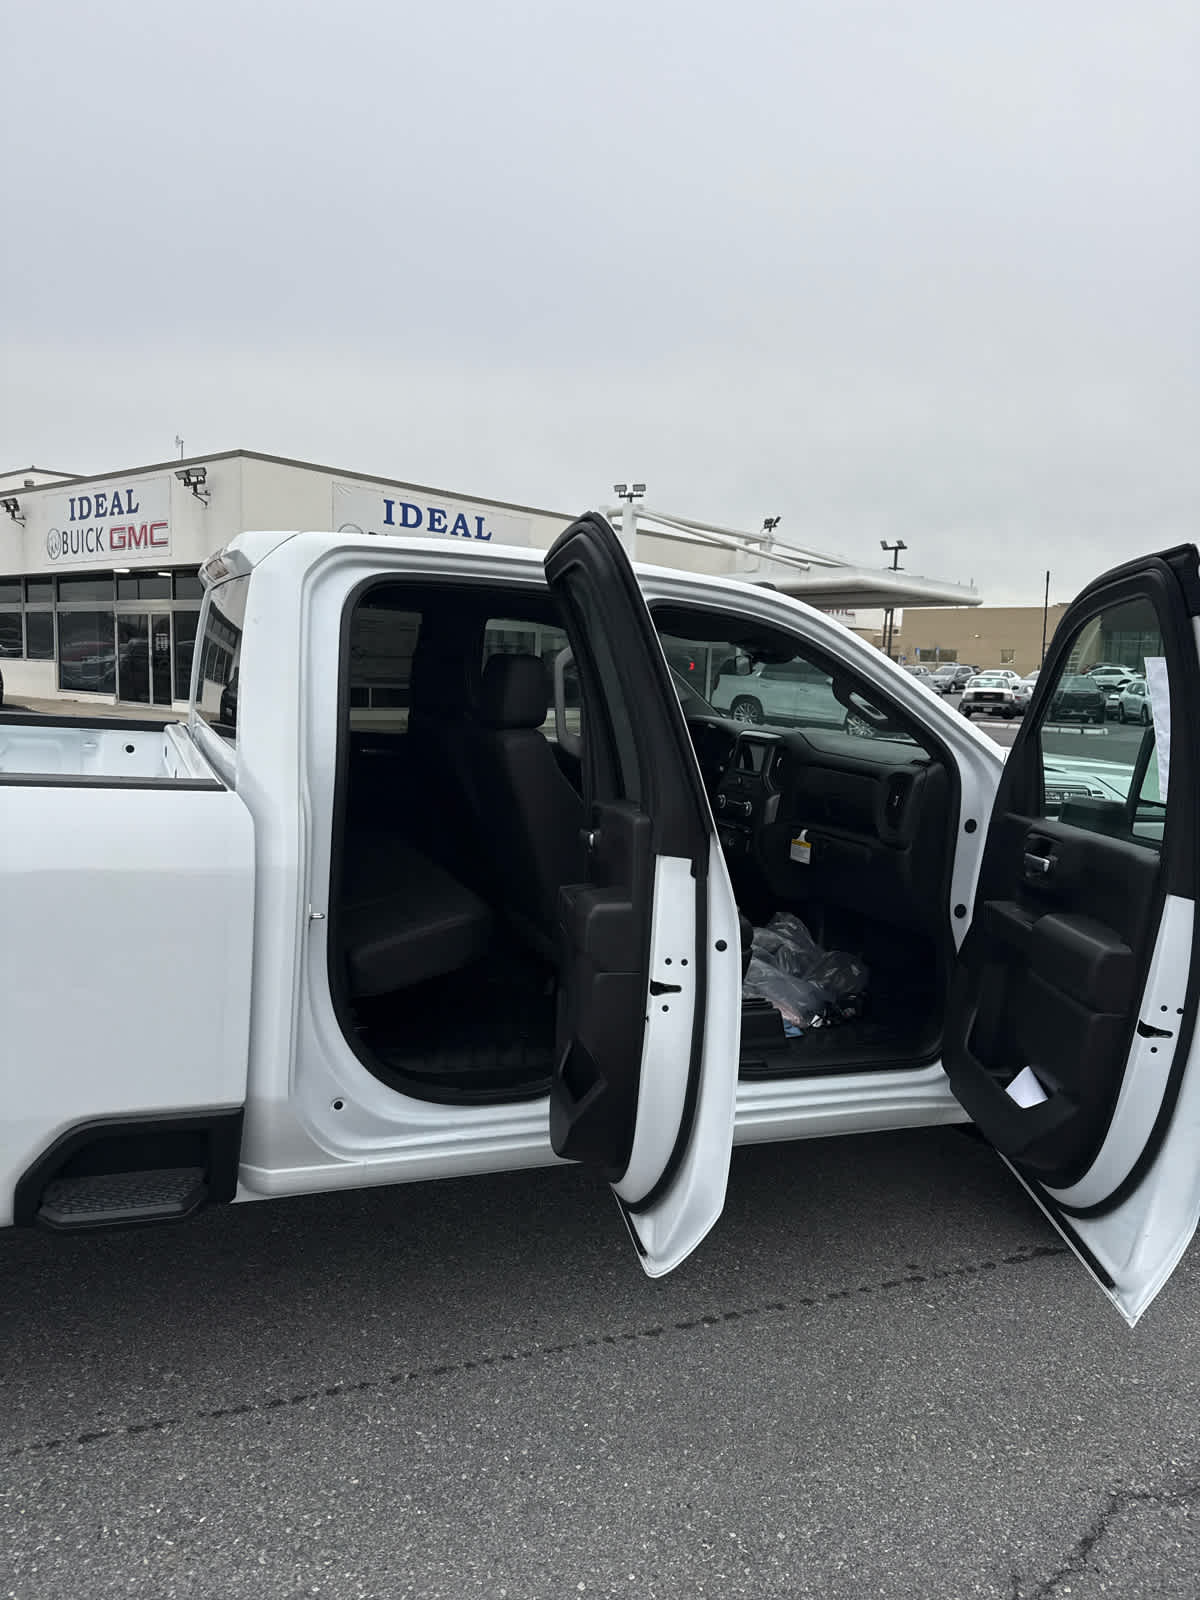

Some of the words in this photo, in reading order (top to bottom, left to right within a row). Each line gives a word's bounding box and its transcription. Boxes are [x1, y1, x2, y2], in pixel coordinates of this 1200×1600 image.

[69, 489, 139, 521] IDEAL
[383, 499, 492, 541] IDEAL
[62, 527, 104, 555] BUICK
[109, 522, 168, 551] GMC
